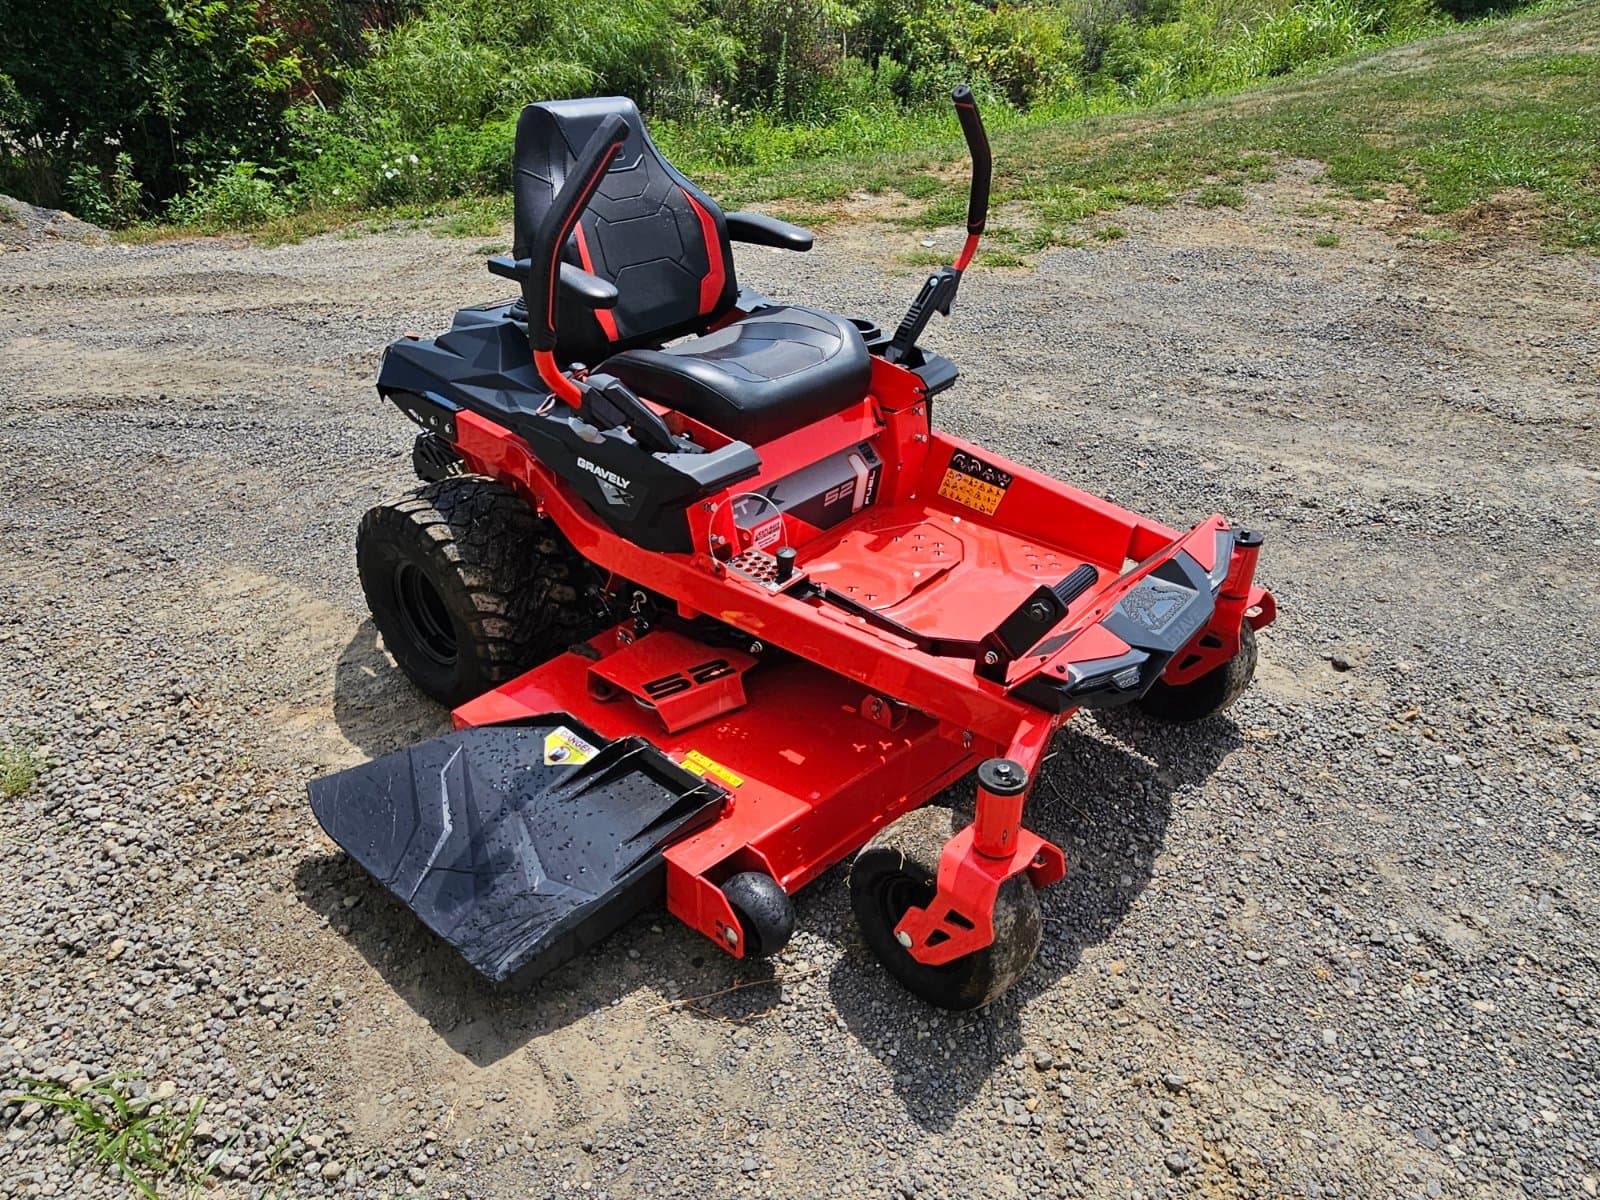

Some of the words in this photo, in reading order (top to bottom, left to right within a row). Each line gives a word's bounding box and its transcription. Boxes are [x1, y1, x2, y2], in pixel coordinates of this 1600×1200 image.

[577, 456, 631, 489] GRAVELY
[864, 470, 876, 505] FUEL
[823, 480, 855, 507] 52
[641, 659, 737, 701] 52
